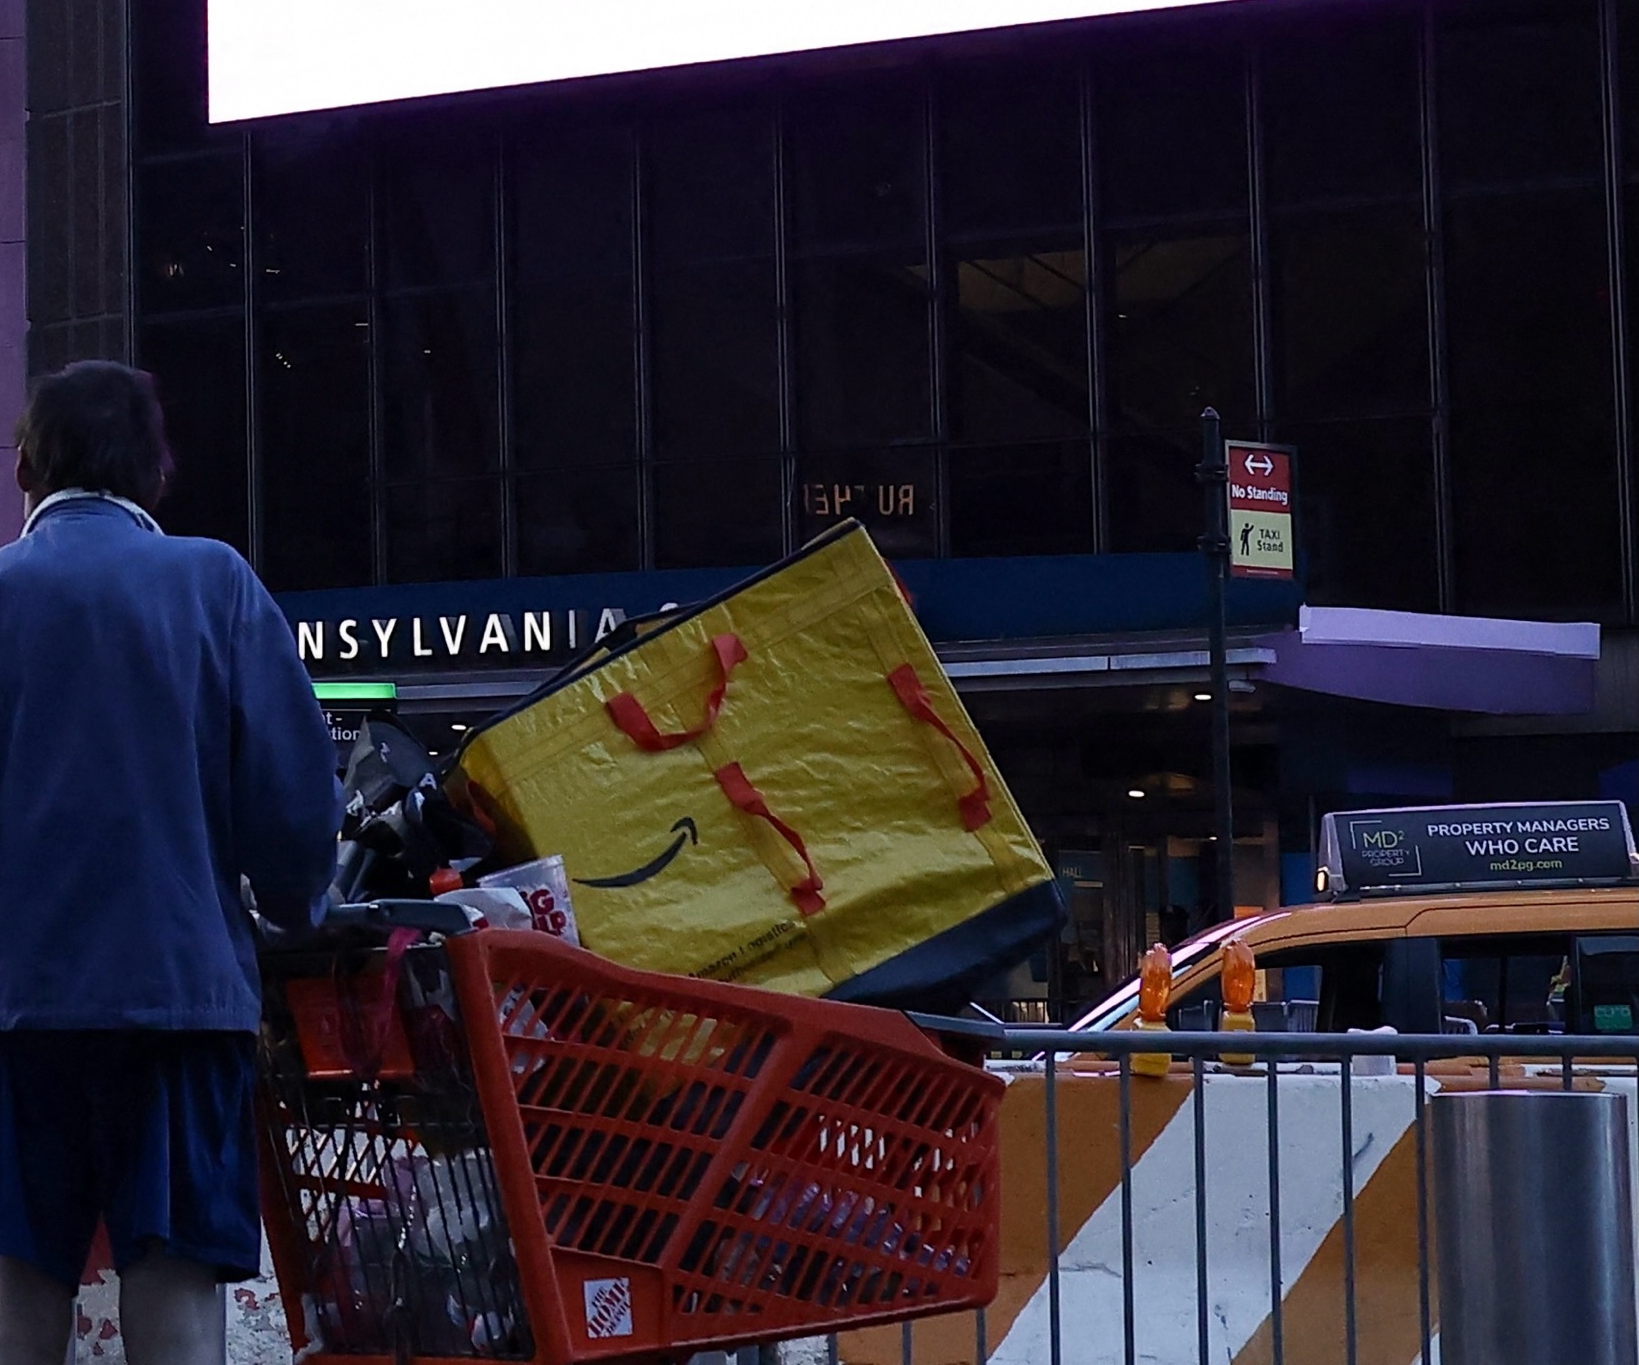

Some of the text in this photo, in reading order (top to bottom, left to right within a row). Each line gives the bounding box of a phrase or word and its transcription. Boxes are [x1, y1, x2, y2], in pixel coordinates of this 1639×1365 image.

[1231, 484, 1288, 506] No Standing
[1259, 529, 1281, 540] TAXI
[1257, 540, 1284, 553] Stand
[1427, 818, 1611, 837] PROPERTY MANAGERS
[1465, 836, 1580, 857] WHO CARE
[1362, 849, 1410, 859] PROPERTY
[1490, 858, 1564, 872] md2pg.com
